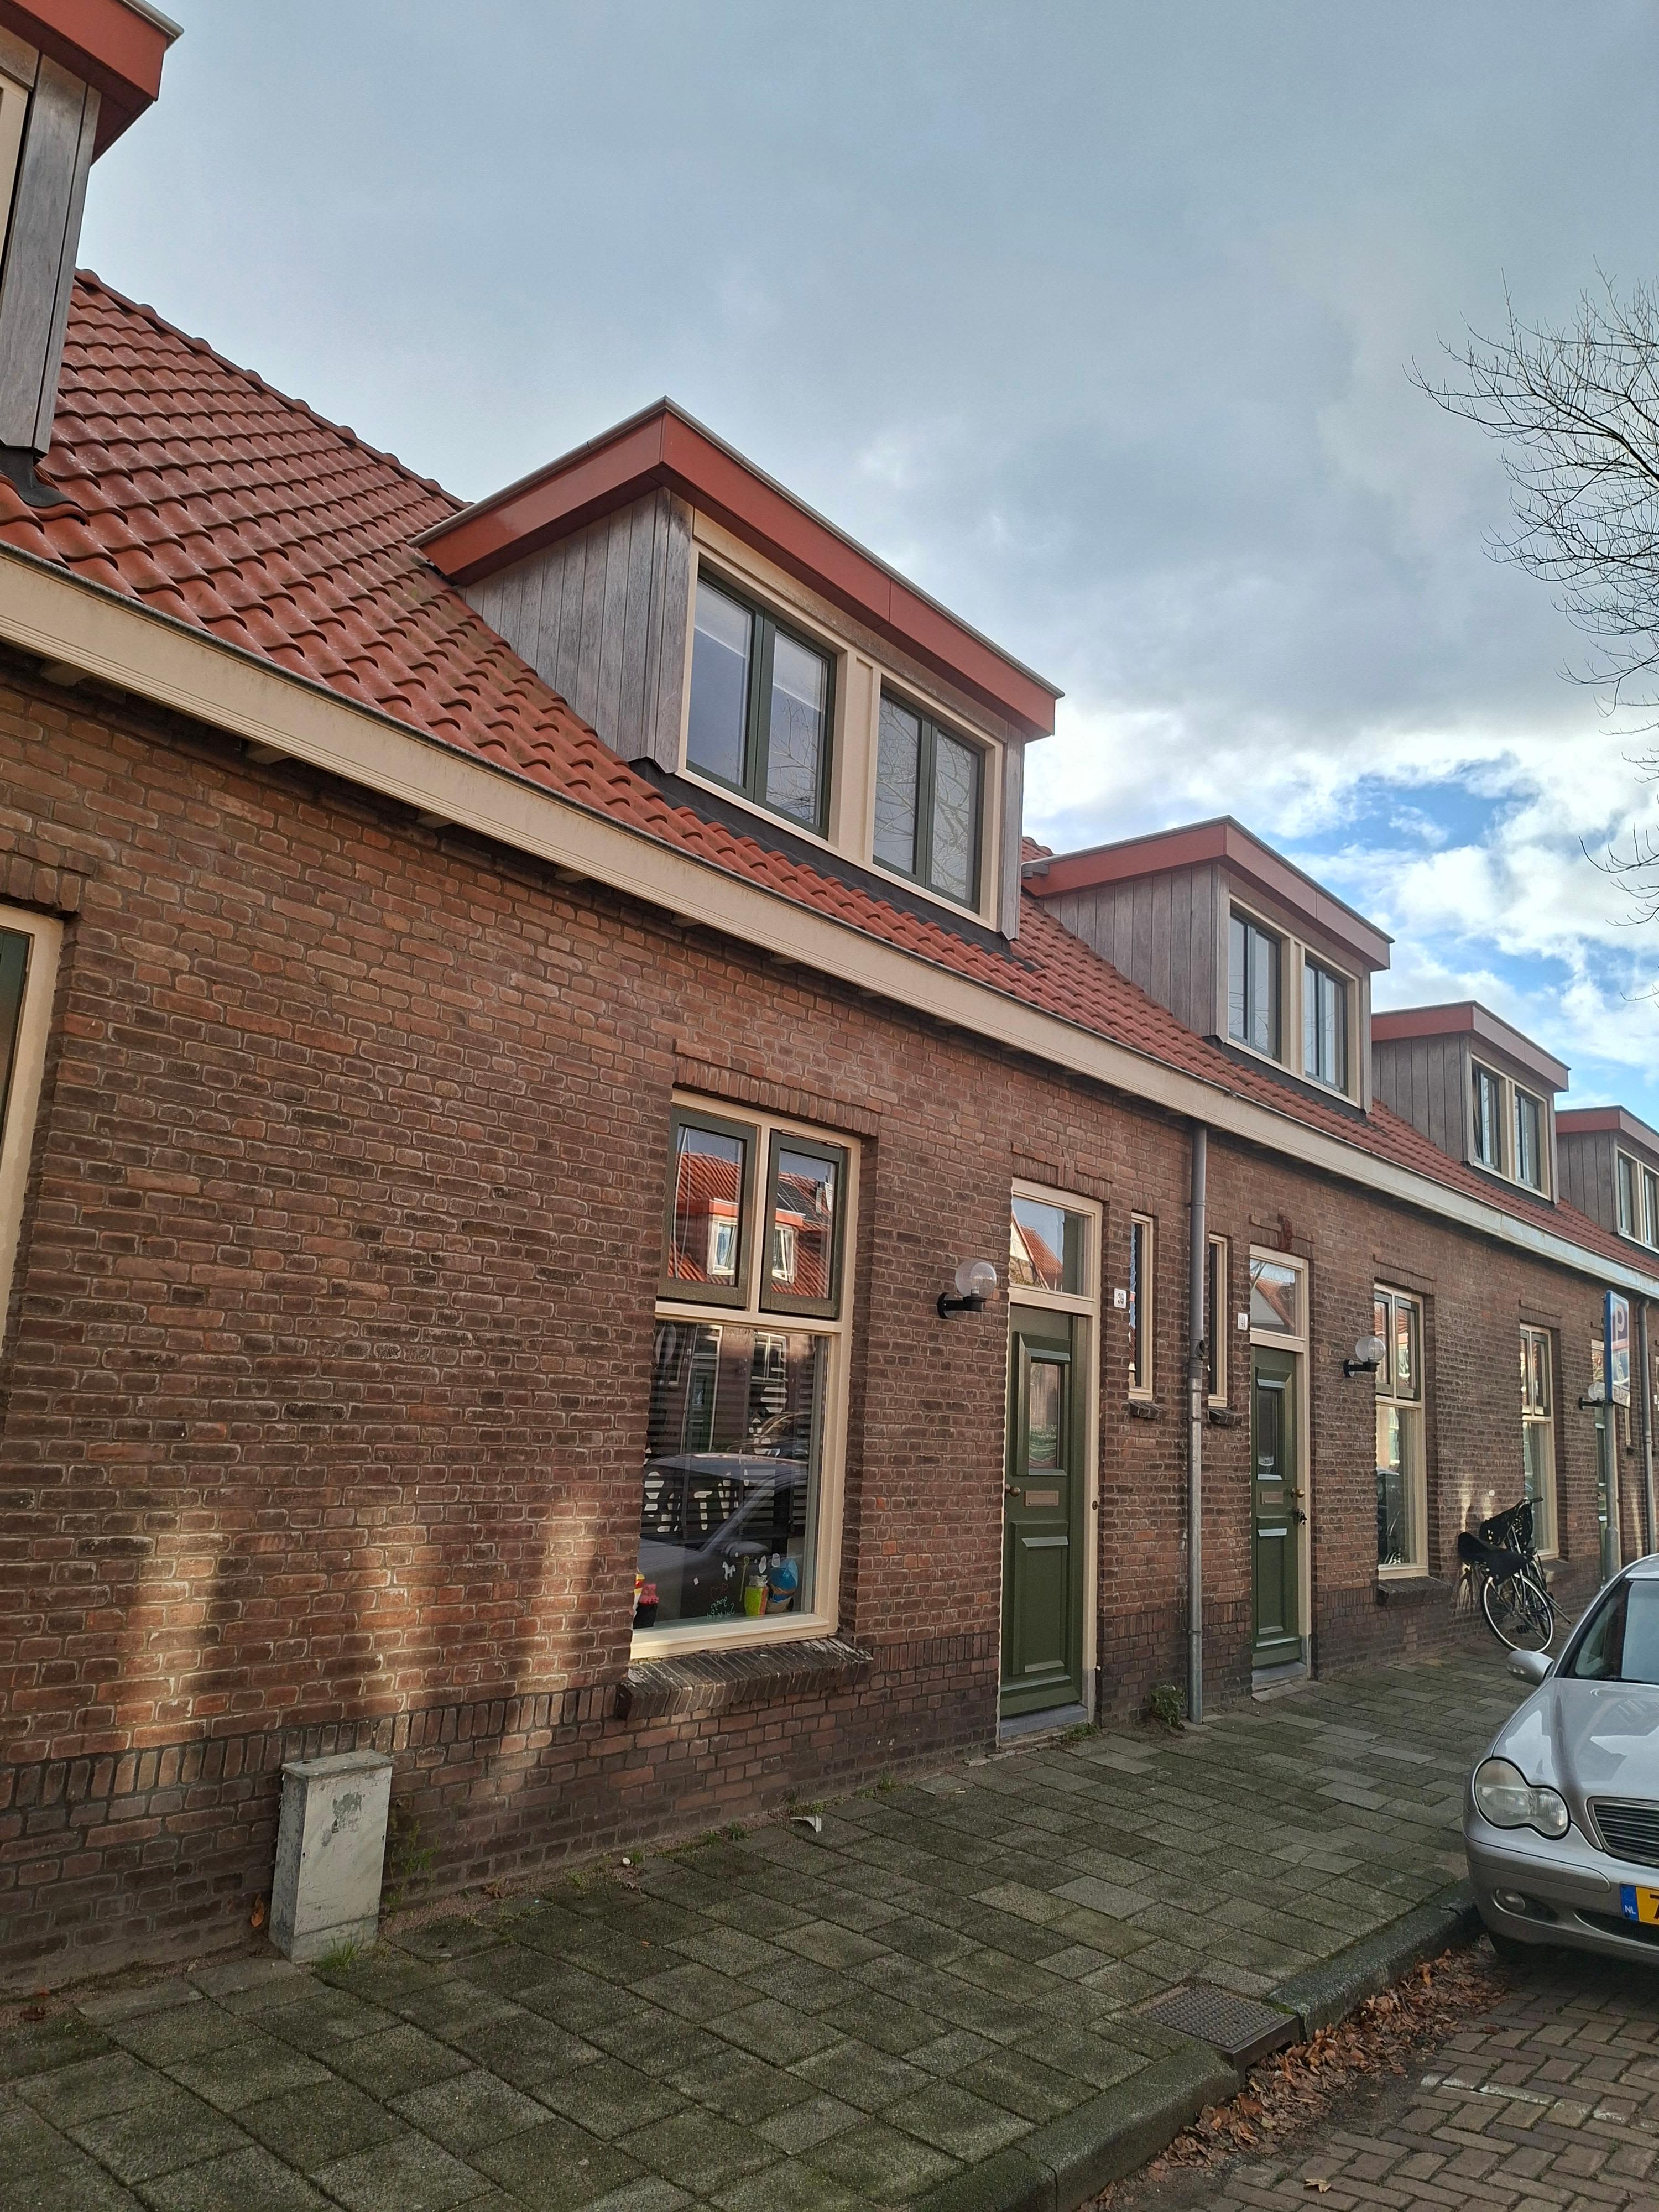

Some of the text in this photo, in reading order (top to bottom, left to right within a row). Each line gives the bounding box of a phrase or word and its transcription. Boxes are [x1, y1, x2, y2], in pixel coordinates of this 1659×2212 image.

[1118, 1292, 1124, 1305] 39
[1614, 1302, 1625, 1346] P
[1624, 1905, 1636, 1914] NL
